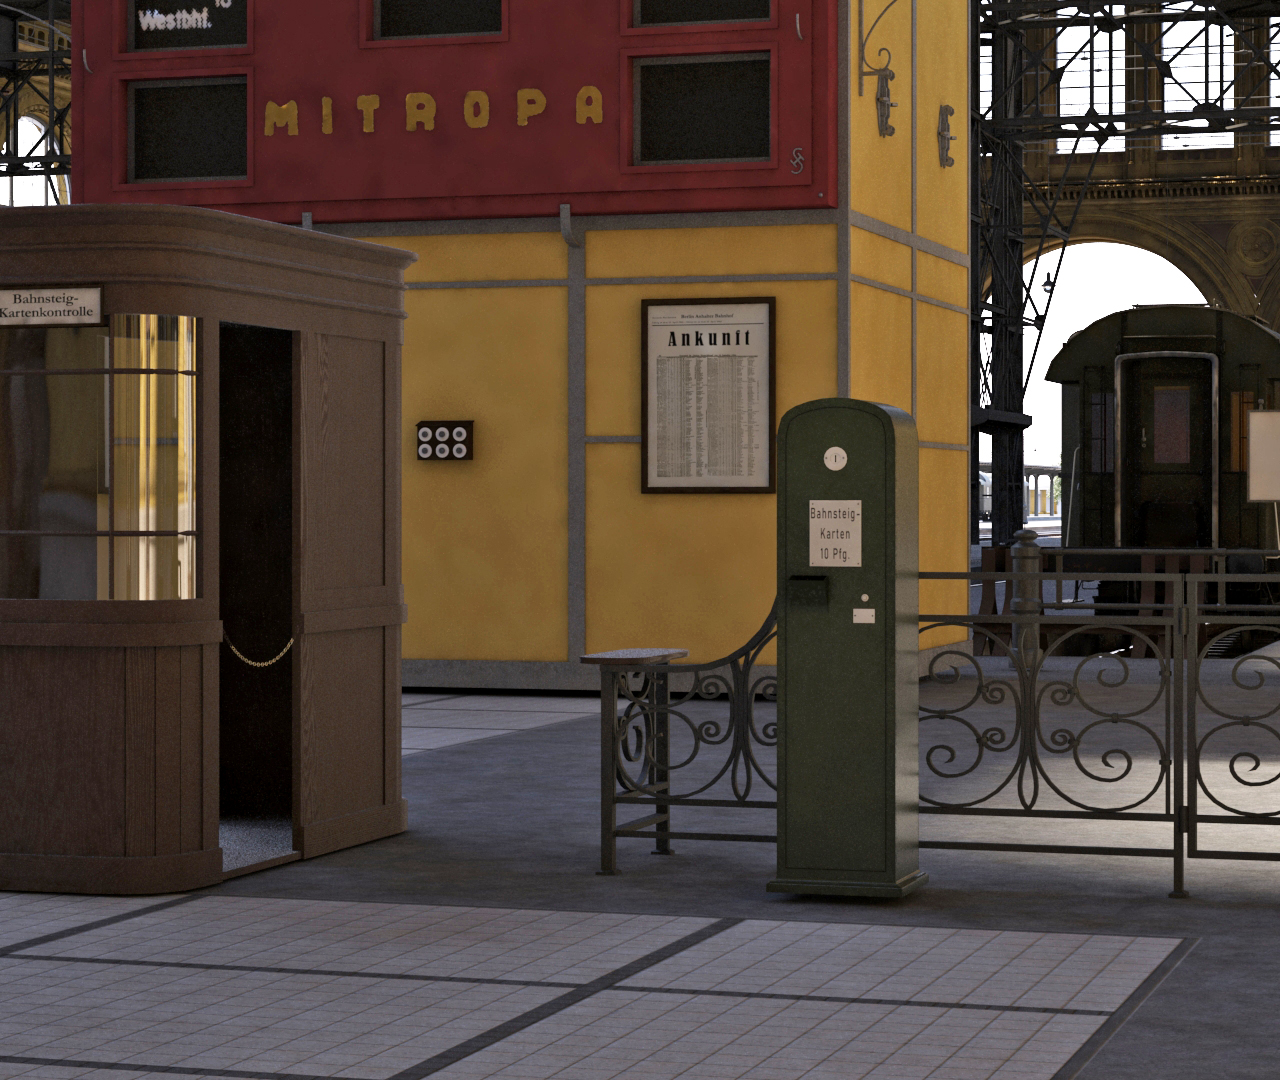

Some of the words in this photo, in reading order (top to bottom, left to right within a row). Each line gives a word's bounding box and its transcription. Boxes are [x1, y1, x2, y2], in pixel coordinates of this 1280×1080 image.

[137, 6, 213, 32] Westbhf.
[263, 85, 604, 137] MITROPA
[12, 292, 79, 306] Bahnsteig-
[668, 330, 750, 346] Ankunft
[811, 508, 860, 522] Bahnsteig-
[821, 528, 851, 539] Karten
[821, 548, 829, 559] 10
[833, 547, 850, 563] Pfg.
